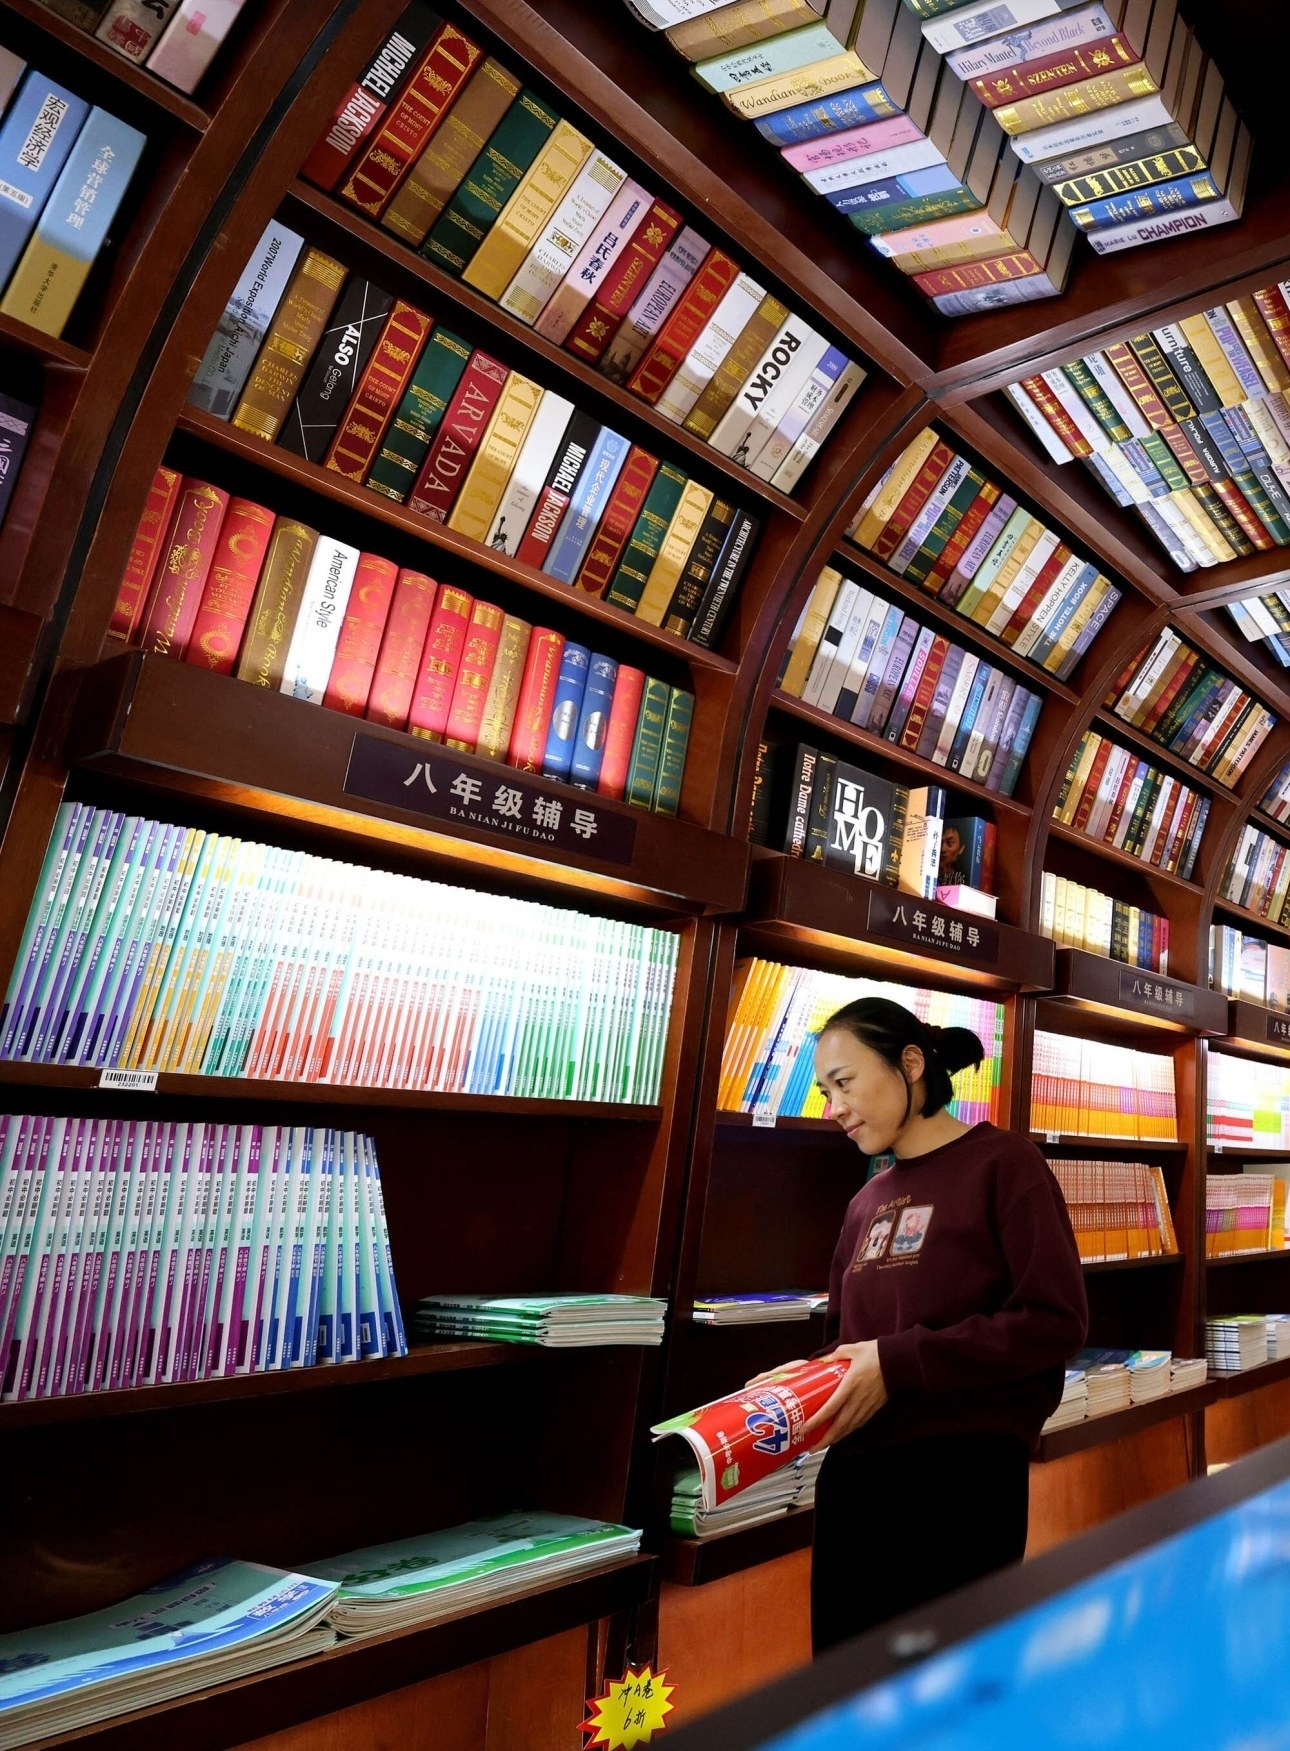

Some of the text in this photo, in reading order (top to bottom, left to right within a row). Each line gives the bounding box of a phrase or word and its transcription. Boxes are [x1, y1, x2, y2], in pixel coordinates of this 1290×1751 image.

[957, 22, 1086, 75] Hilary Mantel Beyond Black
[740, 70, 858, 111] Wandian Book
[1027, 62, 1077, 86] SZENTEN
[325, 32, 416, 155] MICHAEL JACKSON
[20, 96, 66, 169] 宏观经济学
[395, 120, 418, 138] CRISTO
[401, 102, 431, 126] THE COUNT
[401, 112, 411, 121] OF
[65, 145, 116, 230] 全球营销管理
[516, 211, 535, 226] CRISTO
[1103, 213, 1208, 250] MARIE LU CHAMPION
[536, 254, 562, 274] DARWIN
[537, 248, 567, 270] CHARLES
[580, 232, 619, 284] 吕氏春秋
[610, 258, 643, 308] SZENTEN
[218, 237, 282, 374] 2007World Exposition Aichi Japan
[632, 280, 676, 339] EUROPEAN ART
[334, 324, 361, 366] ALSO
[1215, 323, 1260, 390] POP WEASEL
[254, 374, 291, 398] DESCENT
[260, 357, 299, 382] CHARLES
[260, 364, 294, 386] DARWIN
[320, 368, 342, 401] Gelang
[367, 375, 396, 394] THE COUNT
[743, 331, 801, 411] ROCKY
[364, 392, 386, 407] CRISTO
[425, 382, 490, 493] ARVADA
[812, 407, 834, 438] SHAKESPEARE
[937, 459, 965, 496] PATTERSON
[1201, 446, 1220, 474] AURORA
[531, 442, 586, 543] MICHAEL JACKSON
[575, 459, 612, 530] 现代企业管理
[949, 471, 964, 489] JAMES
[963, 530, 994, 573] EUROPEAN ART
[316, 549, 349, 629] American Style
[720, 566, 734, 580] THE
[708, 577, 729, 611] TWENTIETH
[1017, 560, 1080, 650] KELLY HOPPEN STYLE
[1088, 589, 1119, 631] SPACE
[698, 608, 716, 636] CENTURY
[1043, 580, 1088, 648] THE HOTEL BOOK
[863, 672, 880, 695] CROSS
[881, 656, 904, 700] EUROPEAN ART
[965, 684, 984, 727] CHANGELESS
[1222, 728, 1260, 777] JAMES PATTERSON
[403, 761, 598, 840] 八年级辅导
[797, 753, 816, 813] Notre Dame
[450, 806, 555, 842] BA NIAN JI FU DAO
[892, 906, 980, 947] 八年级辅导
[1131, 978, 1184, 1008] 八年级辅导
[117, 1080, 139, 1088] 232201
[17, 1179, 30, 1217] 初中必刷题
[30, 1179, 42, 1217] 初中必刷题
[52, 1179, 63, 1217] 初中必刷题
[66, 1180, 76, 1217] 初中必刷题
[103, 1180, 114, 1216] 初中必刷题
[118, 1180, 128, 1216] 初中必刷题
[160, 1180, 169, 1216] 初中必刷题
[16, 1257, 27, 1285] 八年级下册
[38, 1255, 49, 1283] 八年级下册
[56, 1254, 65, 1282] 八年级下册
[70, 1254, 79, 1281] 八年级下册
[624, 1708, 646, 1730] 6折
